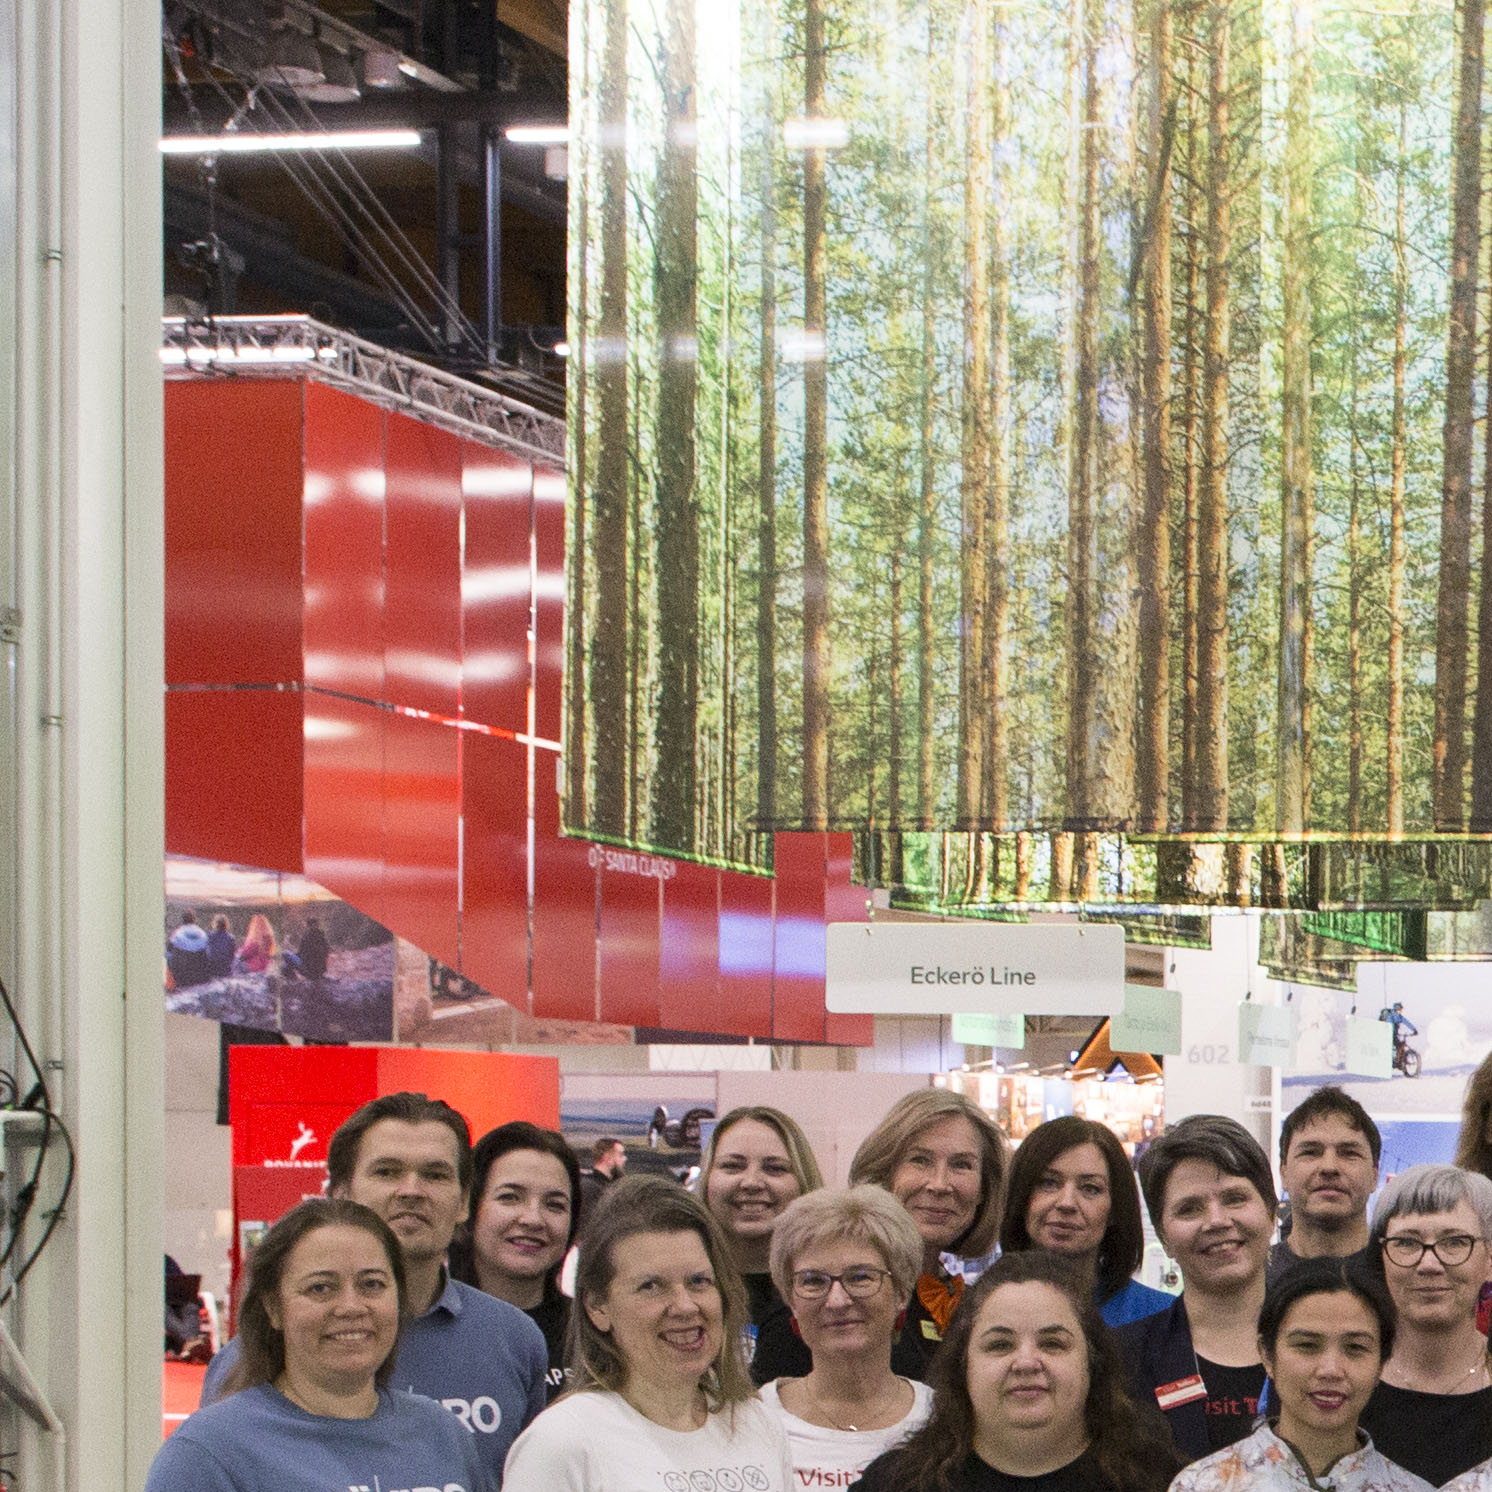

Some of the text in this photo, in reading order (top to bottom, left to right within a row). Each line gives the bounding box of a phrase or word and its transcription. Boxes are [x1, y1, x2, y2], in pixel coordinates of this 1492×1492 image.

[910, 966, 1037, 986] Eckerö Line
[1188, 1044, 1230, 1065] 602
[1204, 1396, 1241, 1415] isit
[797, 1467, 850, 1487] Visit
